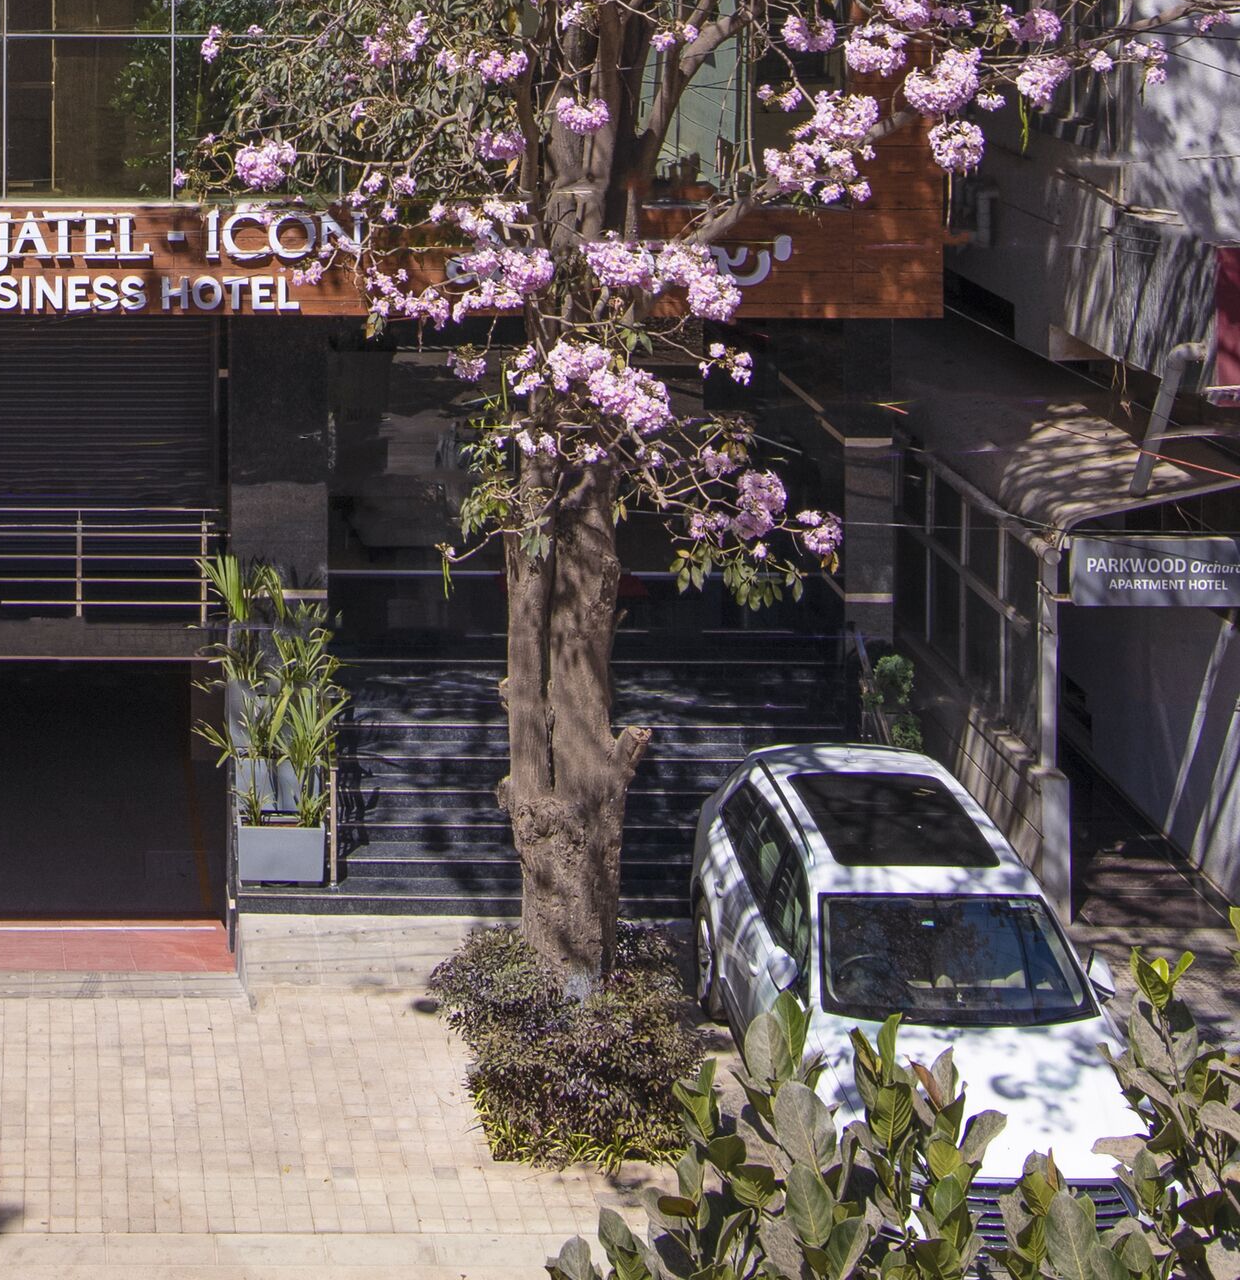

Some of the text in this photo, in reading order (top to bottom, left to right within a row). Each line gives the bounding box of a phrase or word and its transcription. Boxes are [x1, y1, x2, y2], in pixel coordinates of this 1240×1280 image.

[206, 209, 366, 259] ICON
[161, 275, 300, 310] HOTEL
[1087, 558, 1187, 573] PARKWOOD
[1109, 579, 1228, 590] APARTMENT HOTEL
